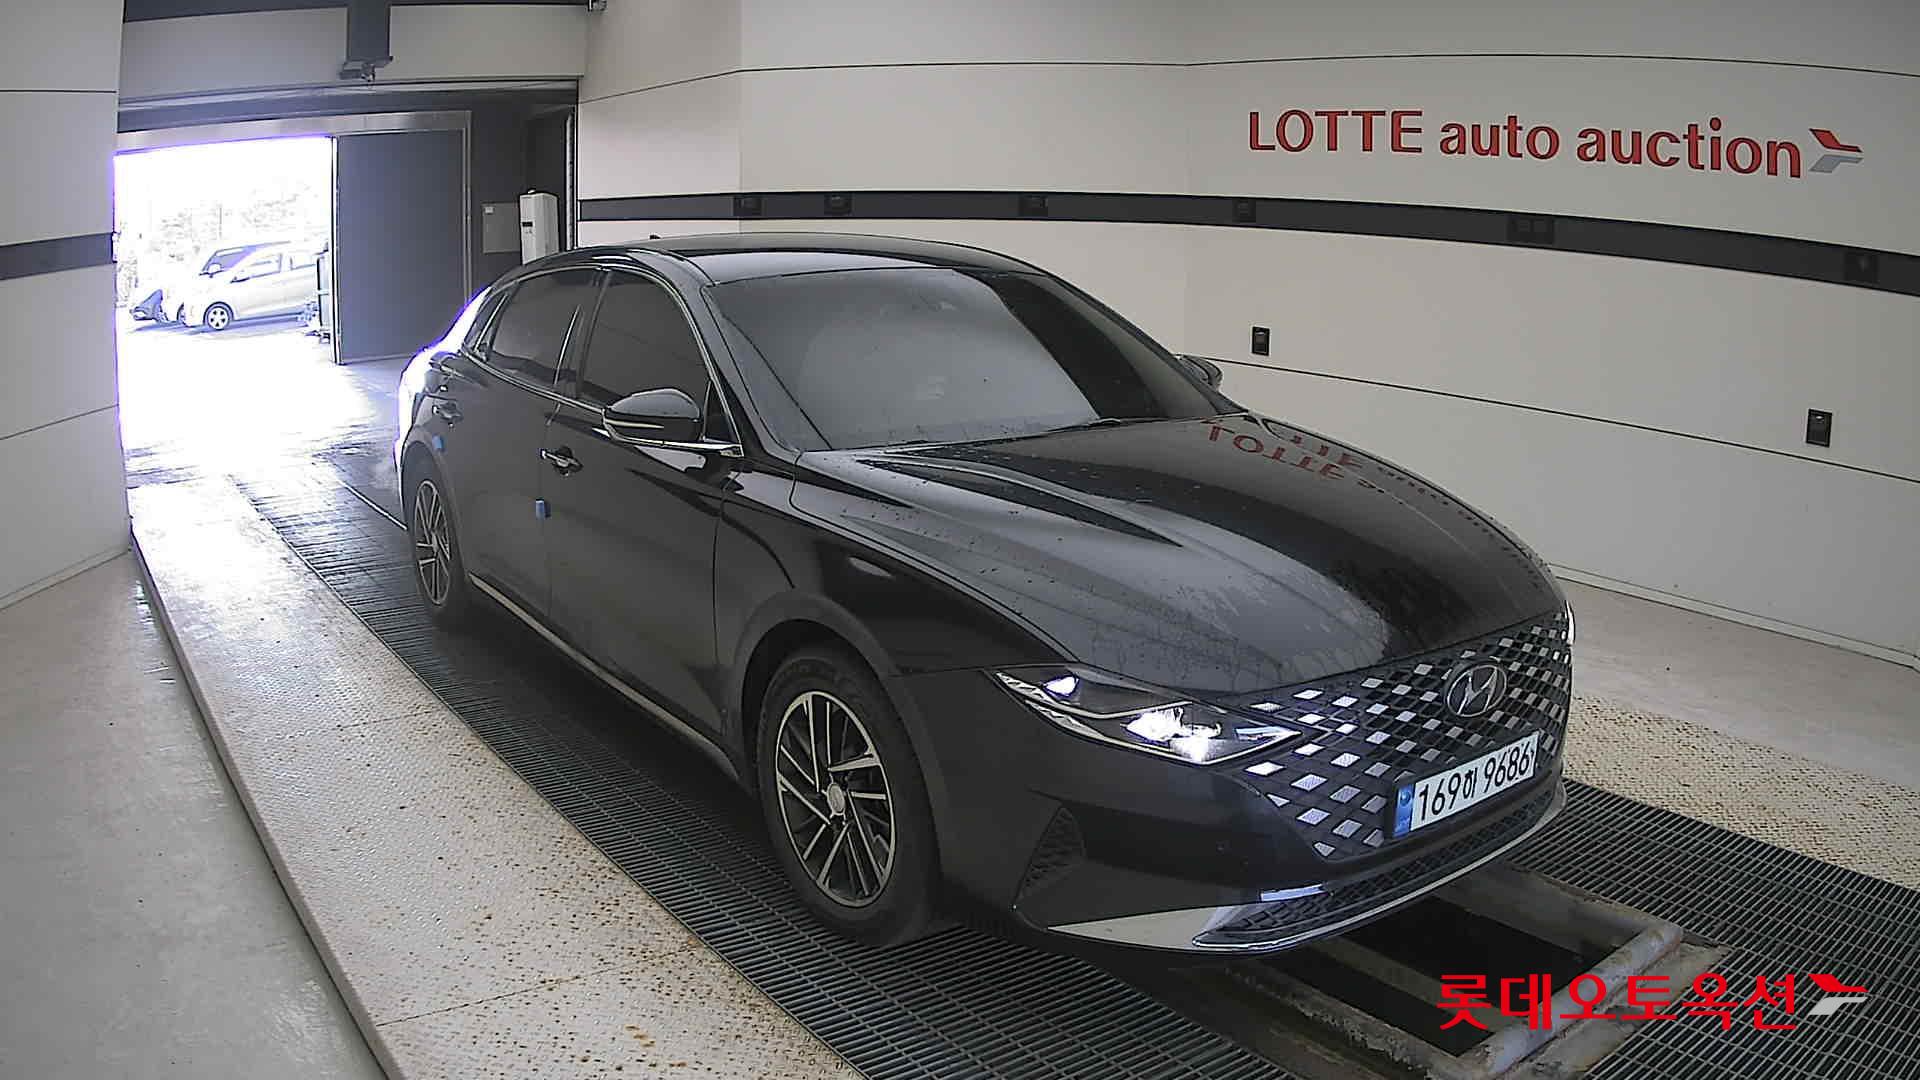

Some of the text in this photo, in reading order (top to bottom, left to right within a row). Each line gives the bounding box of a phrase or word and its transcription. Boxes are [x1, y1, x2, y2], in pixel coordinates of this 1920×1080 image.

[1249, 110, 1802, 179] LOTTE auto auction
[1483, 741, 1530, 793] 9686
